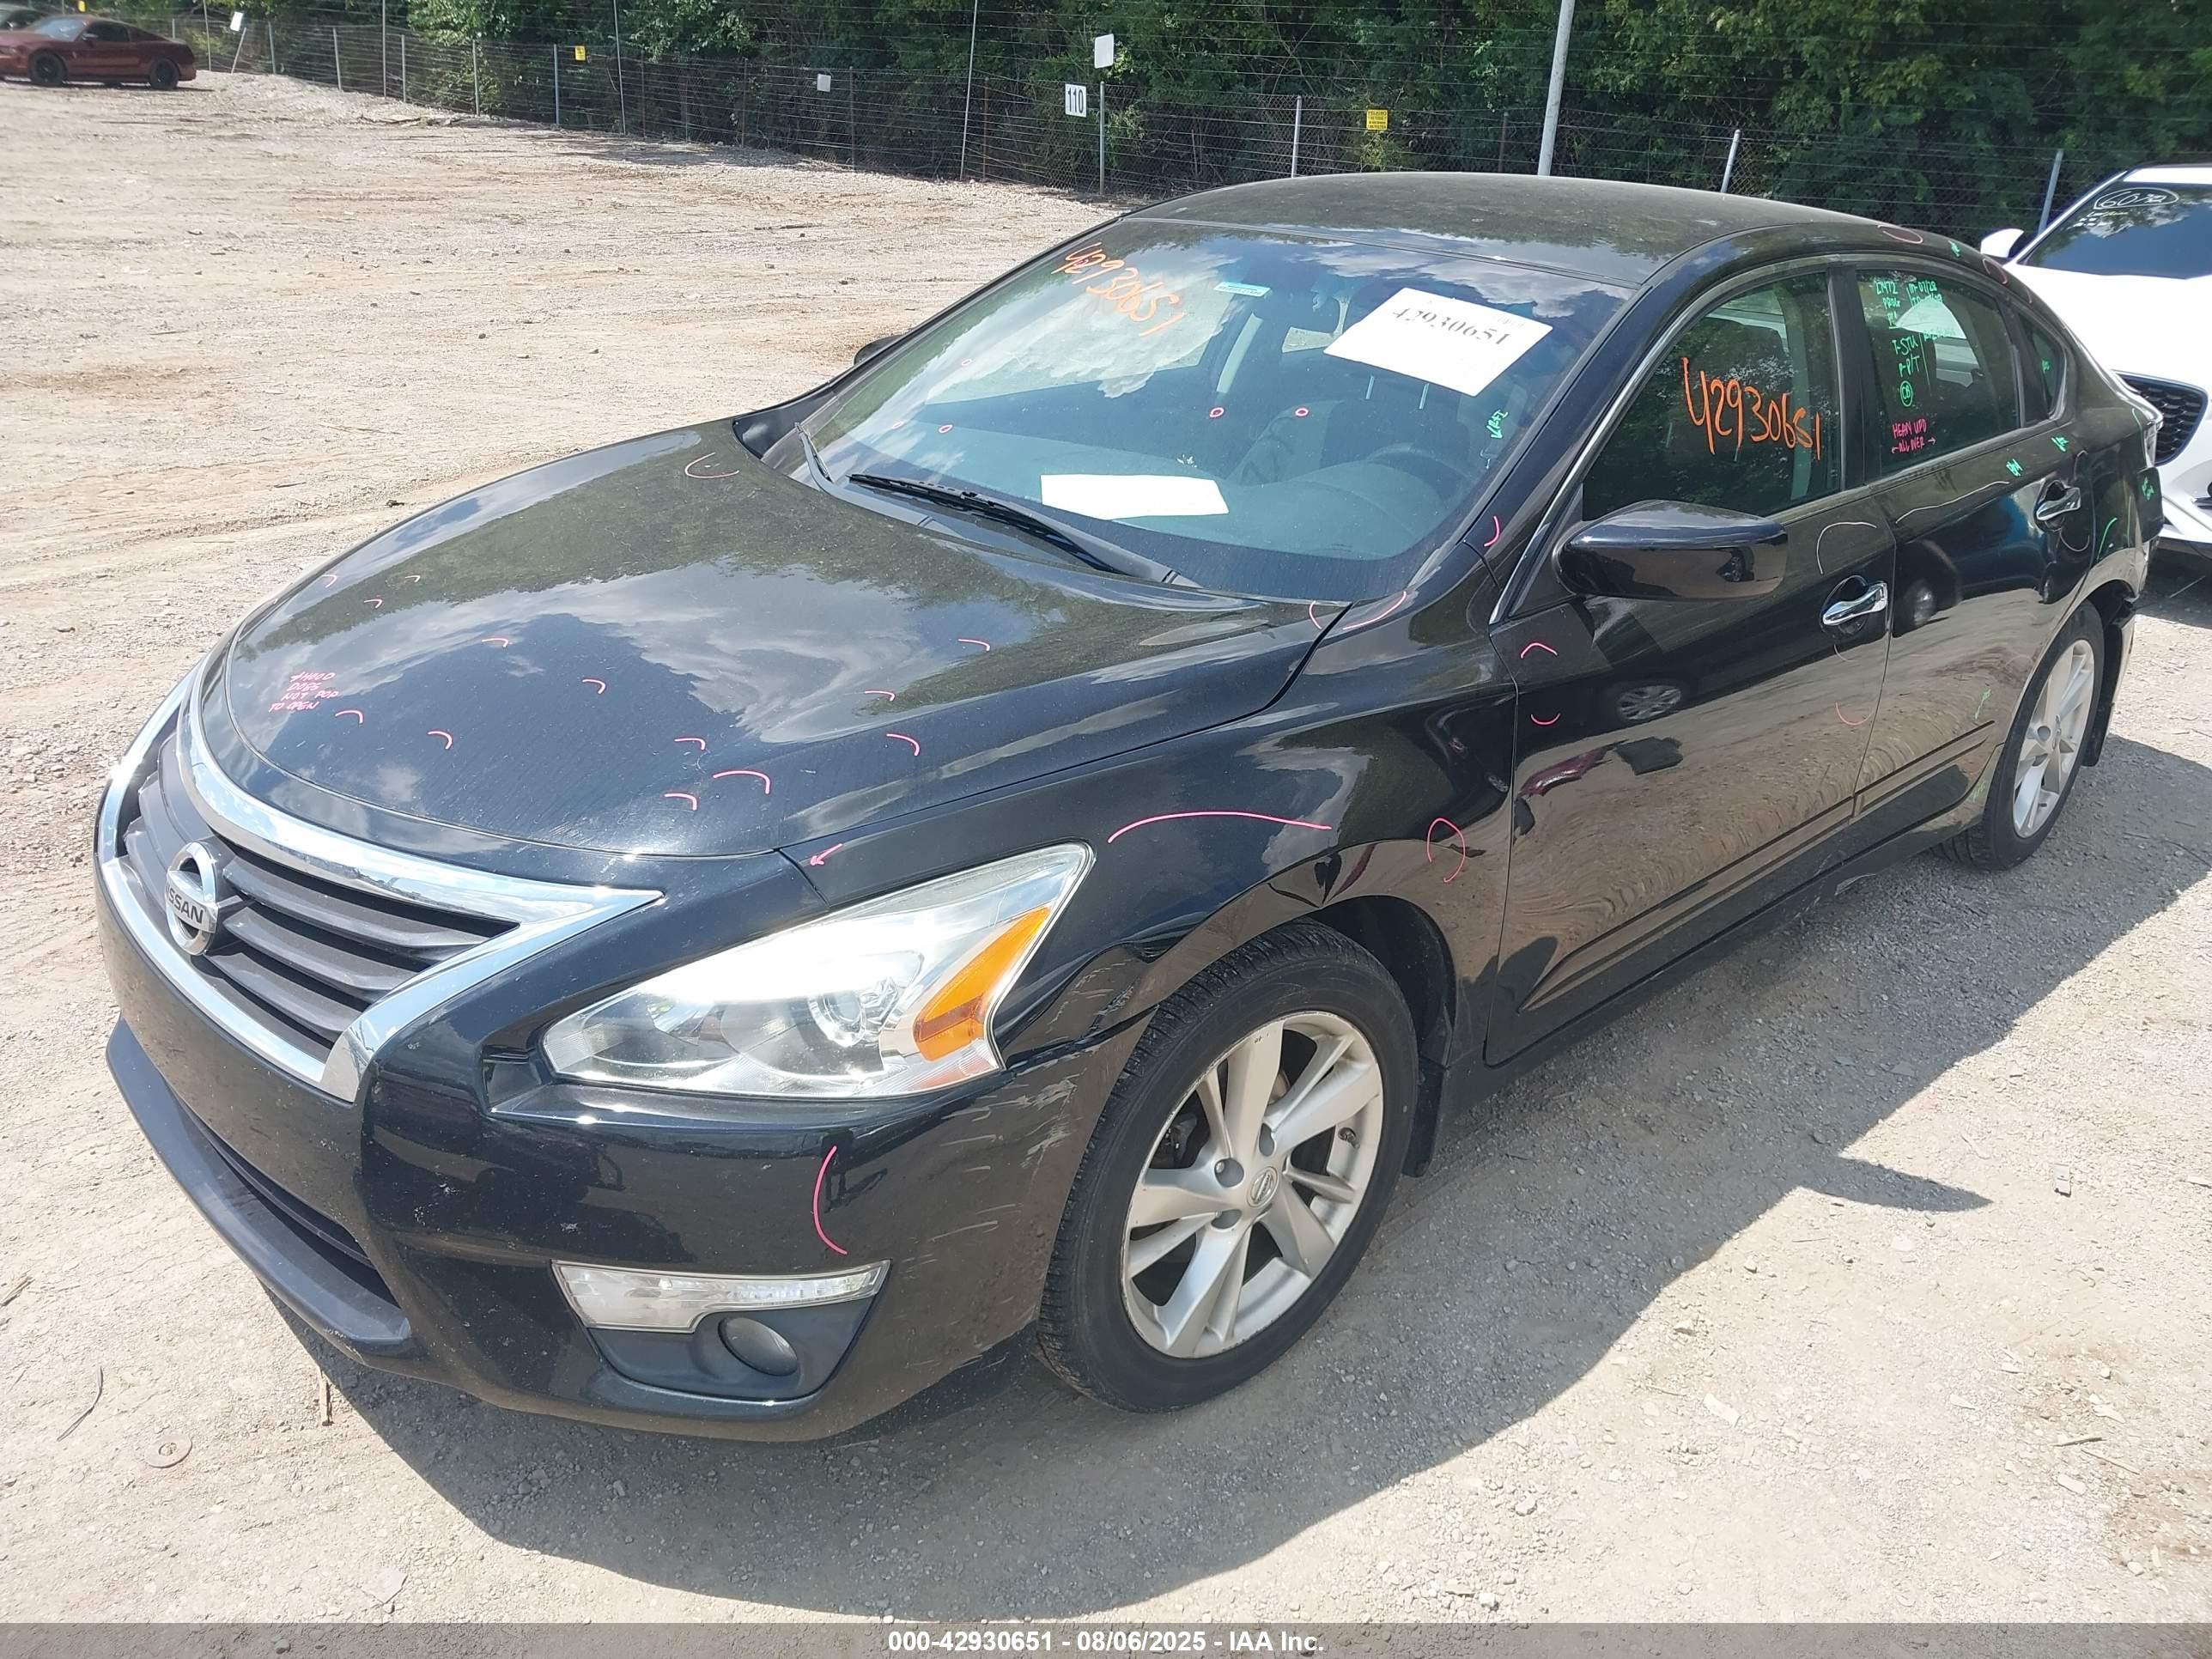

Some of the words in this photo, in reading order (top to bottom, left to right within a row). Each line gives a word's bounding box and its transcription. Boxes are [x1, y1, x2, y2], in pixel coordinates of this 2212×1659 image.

[1067, 87, 1084, 113] 110
[1051, 241, 1188, 337] 42930651
[1393, 307, 1510, 345] 42930651
[1681, 356, 1821, 461] 42930651
